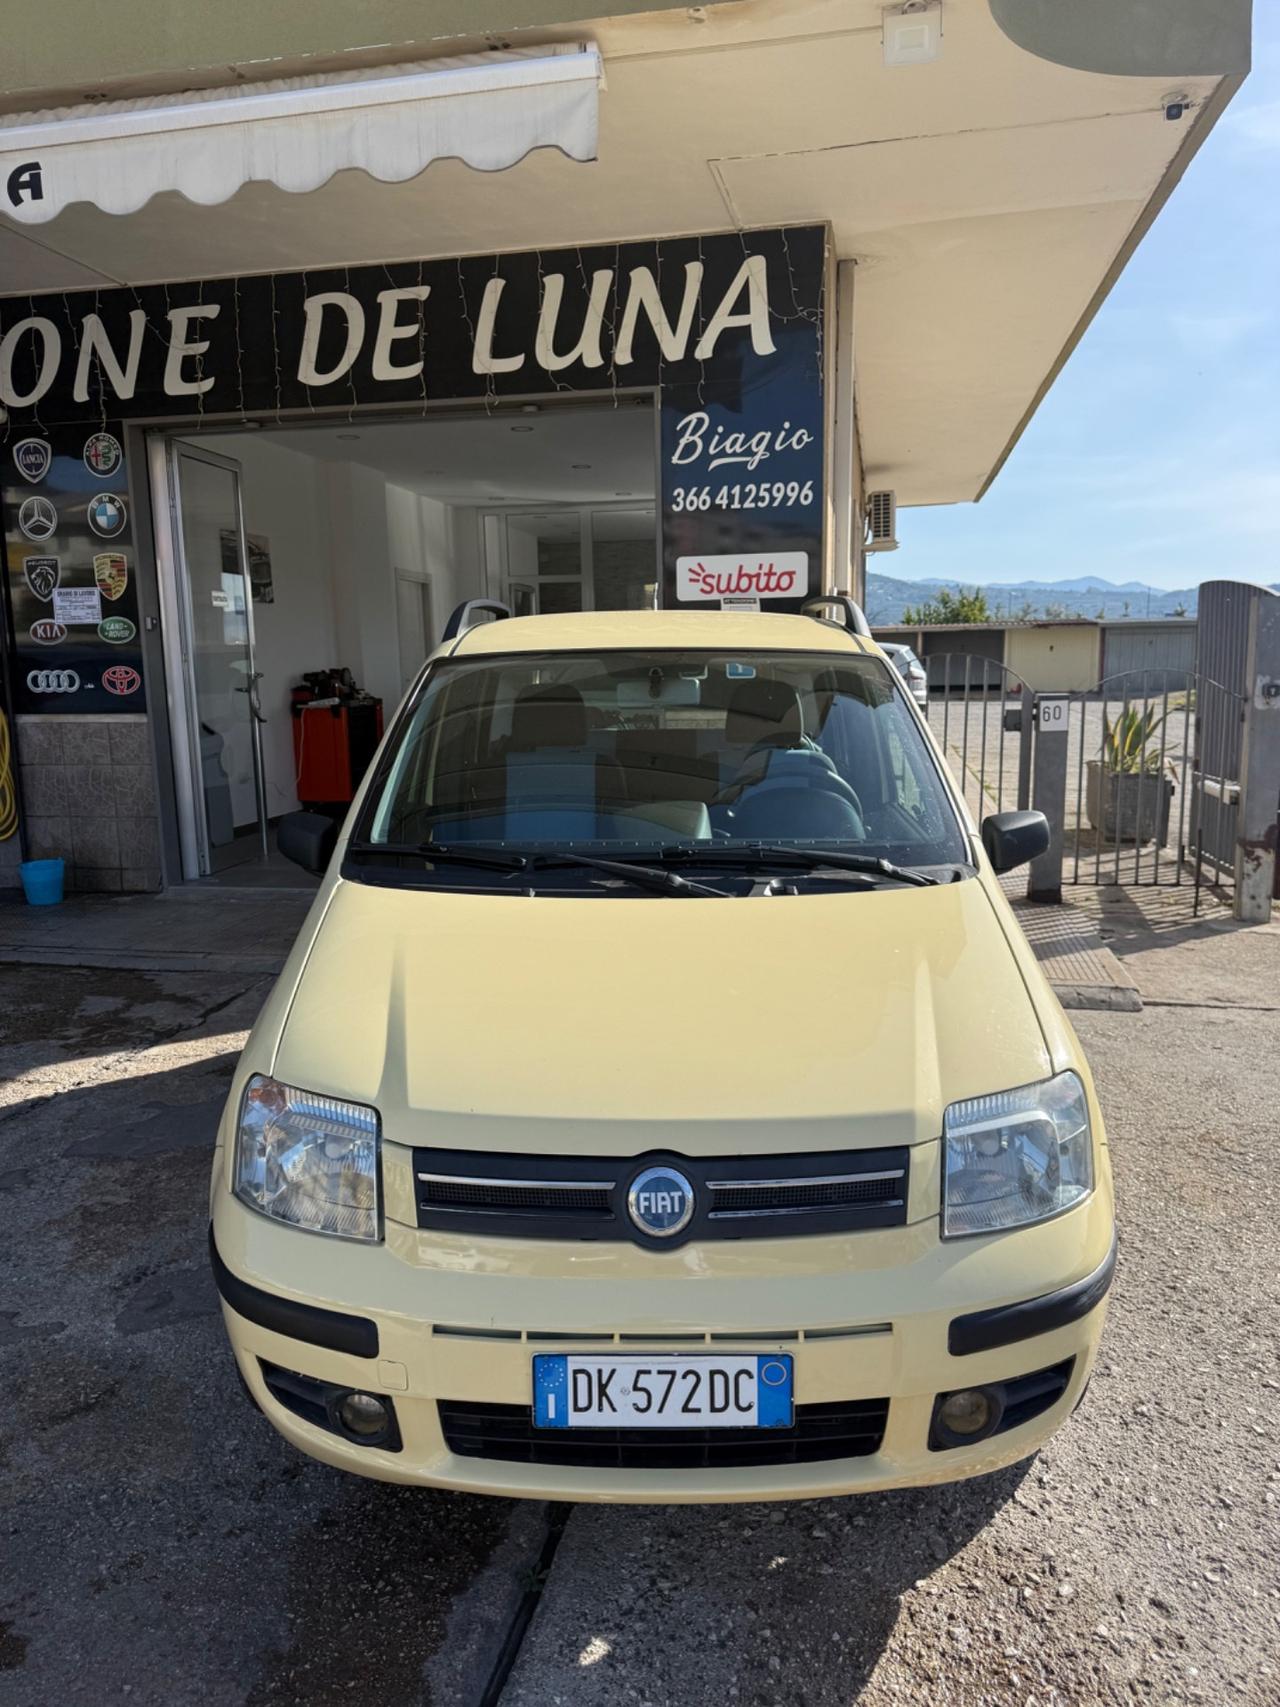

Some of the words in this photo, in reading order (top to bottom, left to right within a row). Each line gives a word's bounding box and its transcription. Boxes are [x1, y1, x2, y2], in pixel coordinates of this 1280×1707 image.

[7, 161, 43, 207] A
[297, 285, 431, 386] DE
[472, 255, 777, 374] LUNA
[671, 411, 814, 472] Biagio
[23, 453, 43, 464] LANCIA
[672, 486, 711, 512] 366
[715, 480, 814, 509] 4125996
[700, 563, 796, 595] subito
[36, 625, 61, 639] KIA
[1042, 705, 1061, 722] 60
[639, 1191, 683, 1214] FIAT
[572, 1368, 618, 1413] DK
[632, 1368, 755, 1413] 572DC
